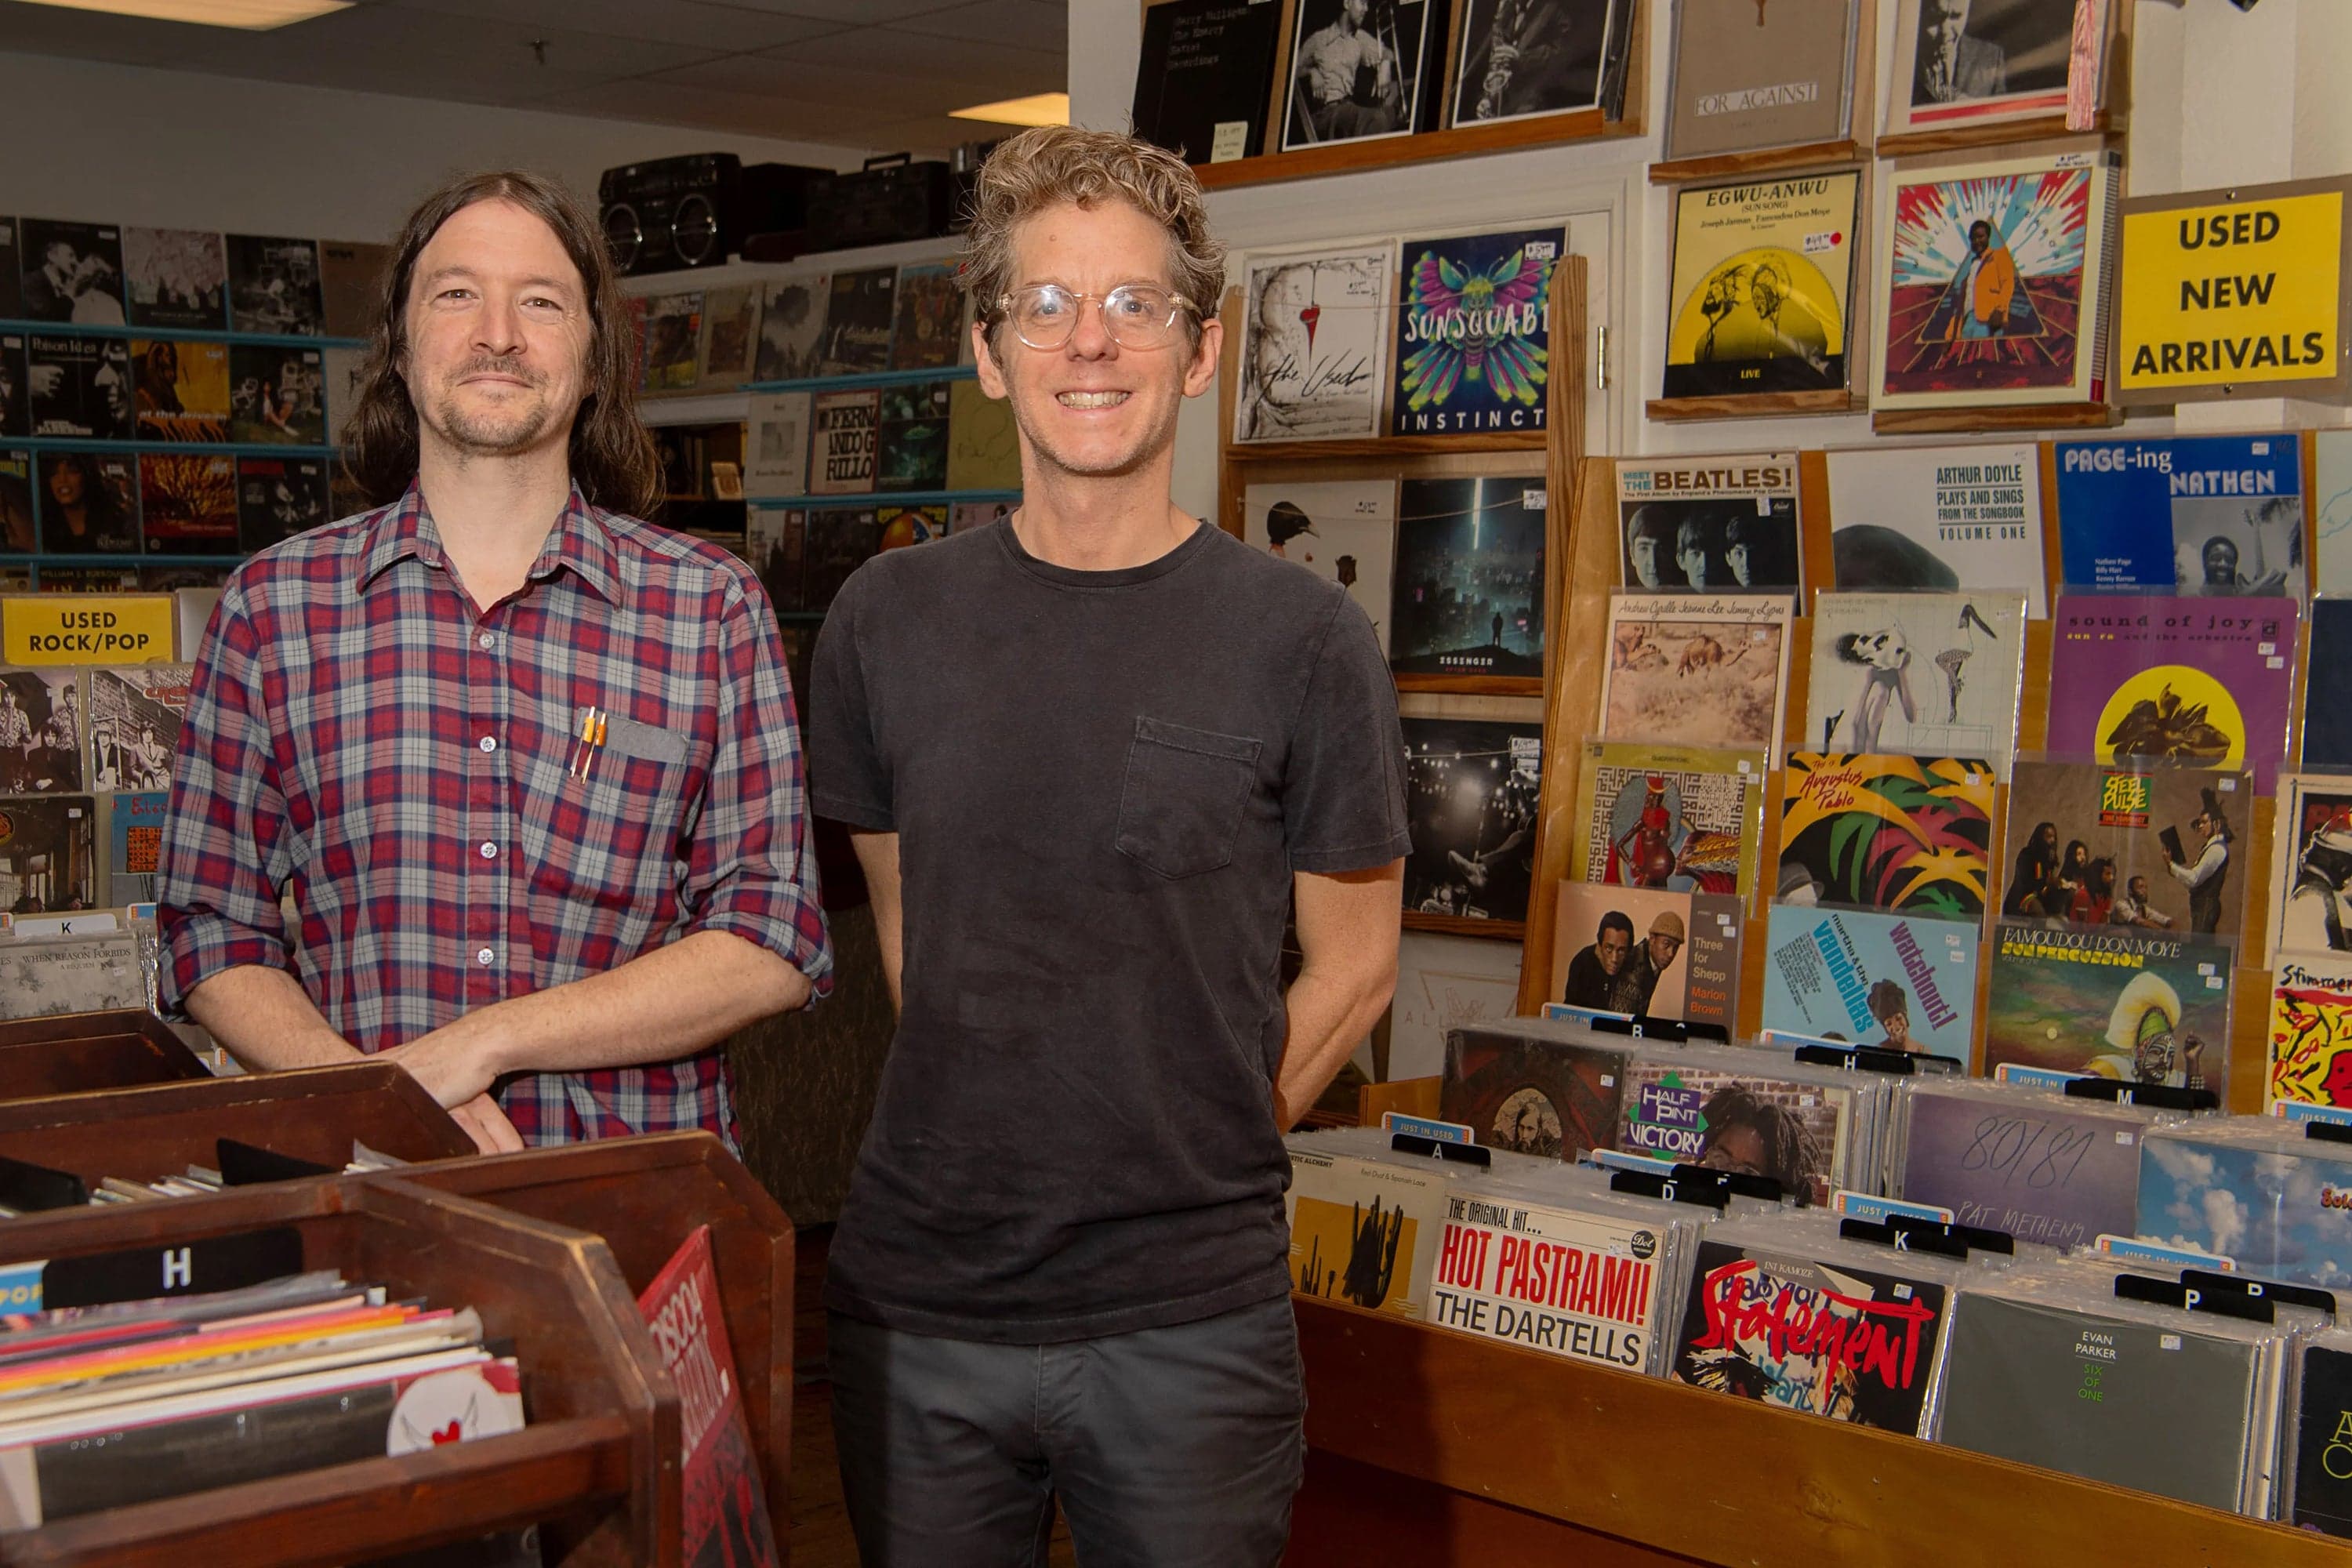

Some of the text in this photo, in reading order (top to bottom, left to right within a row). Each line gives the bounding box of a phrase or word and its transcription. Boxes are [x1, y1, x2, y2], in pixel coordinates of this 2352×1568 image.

[1695, 83, 1816, 115] FOR AGAINST
[1706, 180, 1828, 207] EGWU-ANWU
[2179, 210, 2281, 251] USED
[2180, 272, 2277, 312] NEW
[2131, 332, 2324, 376] ARRIVALS
[1740, 368, 1761, 379] LIVE
[1401, 408, 1544, 431] INSTINCT
[2064, 446, 2172, 474] PAGE-ing
[1623, 468, 1791, 491] MEET BEATLES!
[1936, 464, 2022, 485] ARTHUR DOYLE
[2170, 470, 2275, 495] NATHEN
[1624, 481, 1651, 491] THE
[1937, 488, 2024, 505] PLAYS AND SINGS
[1938, 506, 2024, 521] FROM THE SONGBOOK
[1940, 526, 2026, 541] VOLUME ONE
[61, 612, 118, 629] USED
[2069, 615, 2252, 630] sound of joy
[30, 632, 149, 654] ROCK/POP
[1799, 768, 1862, 800] Augustus
[1818, 789, 1855, 810] Pablo
[61, 922, 71, 934] K
[1694, 937, 1724, 951] Three
[1831, 913, 1857, 960] martha
[1857, 964, 1869, 986] the
[2002, 927, 2182, 959] FAMOUDOU DON MOYE
[22, 947, 131, 964] WHEN REASON FORBIDS
[1693, 952, 1708, 963] for
[1693, 967, 1726, 983] Shepp
[1813, 920, 1875, 1034] vandellas
[1889, 920, 1958, 1031] watchout!
[1692, 986, 1726, 1001] Marion
[1690, 1002, 1723, 1016] Brown
[1632, 1025, 1643, 1039] B
[1844, 1054, 1857, 1071] H
[2018, 1075, 2058, 1089] JUST IN
[1643, 1087, 1691, 1106] HALF
[2117, 1089, 2133, 1105] M
[1656, 1105, 1698, 1123] PINT
[2299, 1112, 2327, 1123] JUST
[1400, 1122, 1418, 1132] JUST
[1421, 1126, 1431, 1135] IN
[1433, 1129, 1454, 1140] USED
[1629, 1122, 1705, 1156] VICTORY
[1432, 1142, 1443, 1160] A
[1962, 1113, 2095, 1190] 80/81
[1662, 1183, 1675, 1201] D
[1449, 1198, 1542, 1235] THE ORIGINAL HIT...
[1857, 1204, 1882, 1215] JUST
[1958, 1200, 1997, 1225] PAT
[1632, 1232, 1655, 1249] Dot
[1895, 1230, 1910, 1252] K
[162, 1247, 191, 1290] H
[1438, 1224, 1652, 1326] HOT PASTRAMI!
[1764, 1261, 1814, 1279] INI KAMOZE
[2185, 1289, 2201, 1311] P
[1435, 1290, 1642, 1367] THE DARTELLS
[1690, 1259, 1936, 1416] Statement
[2082, 1331, 2113, 1345] EVAN
[2075, 1343, 2117, 1360] PARKER
[2084, 1363, 2103, 1376] SIX
[2084, 1377, 2100, 1387] OF
[2078, 1388, 2103, 1402] ONE
